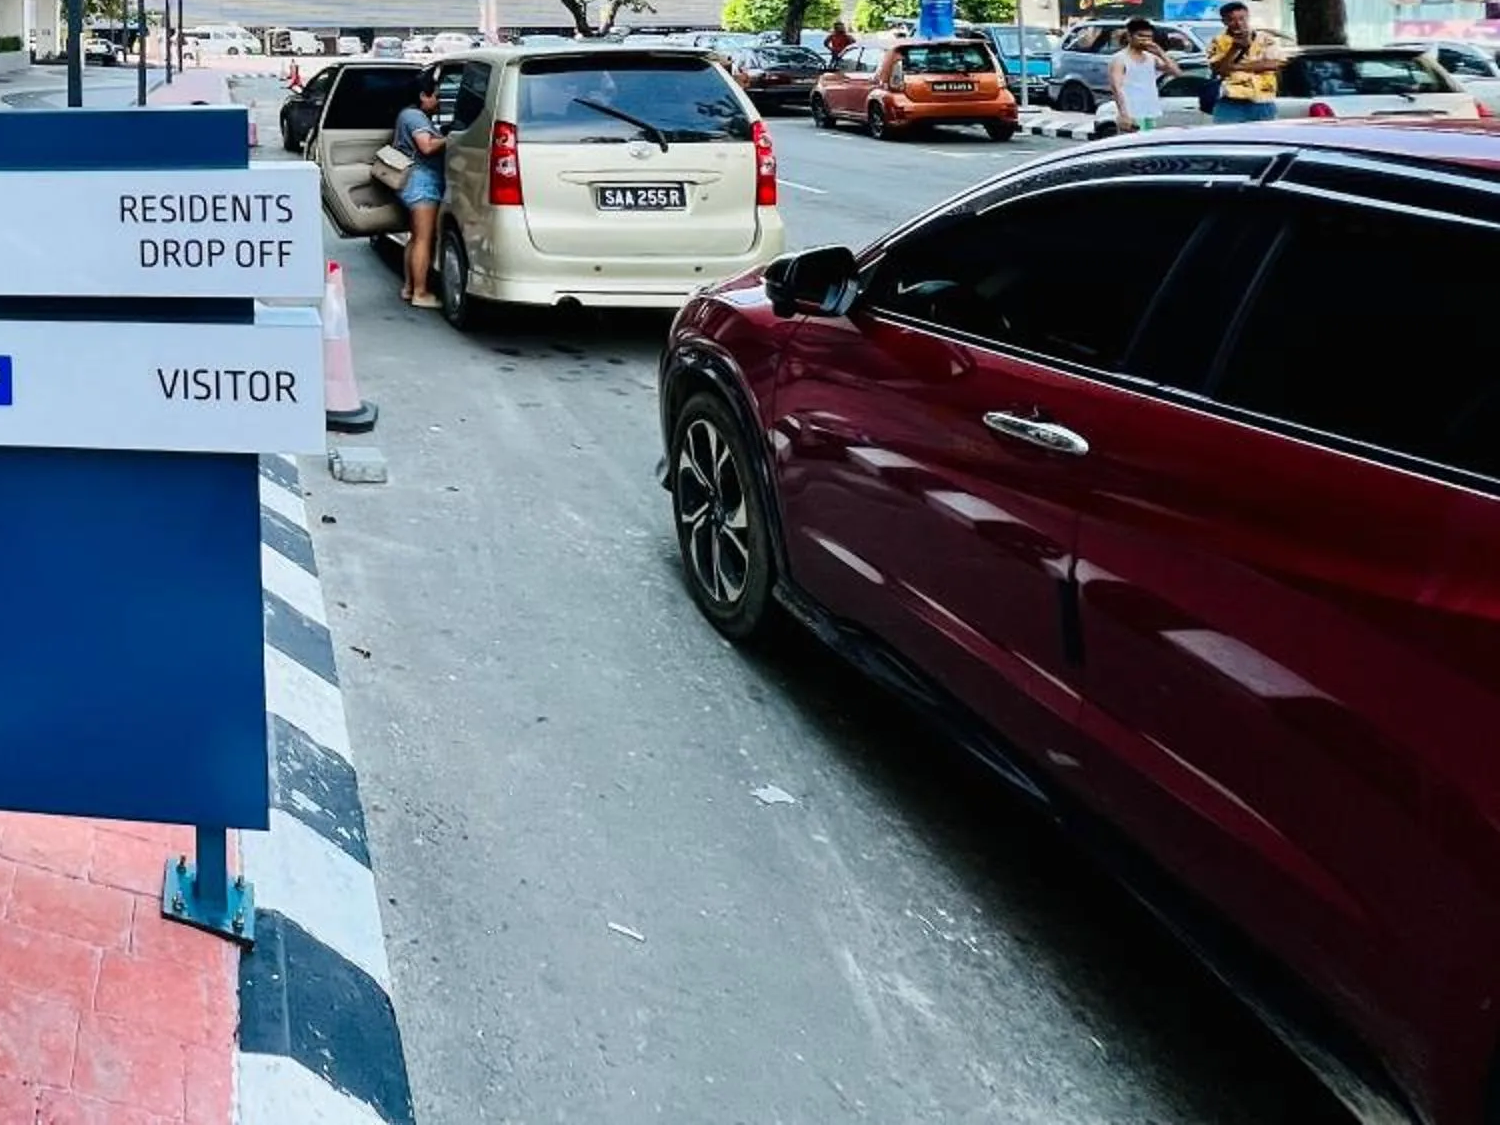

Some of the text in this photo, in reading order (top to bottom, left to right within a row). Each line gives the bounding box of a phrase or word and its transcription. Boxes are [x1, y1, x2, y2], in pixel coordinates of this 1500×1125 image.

[119, 194, 293, 223] RESIDENTS
[139, 239, 293, 268] DROP OFF
[157, 368, 298, 403] VISITOR
